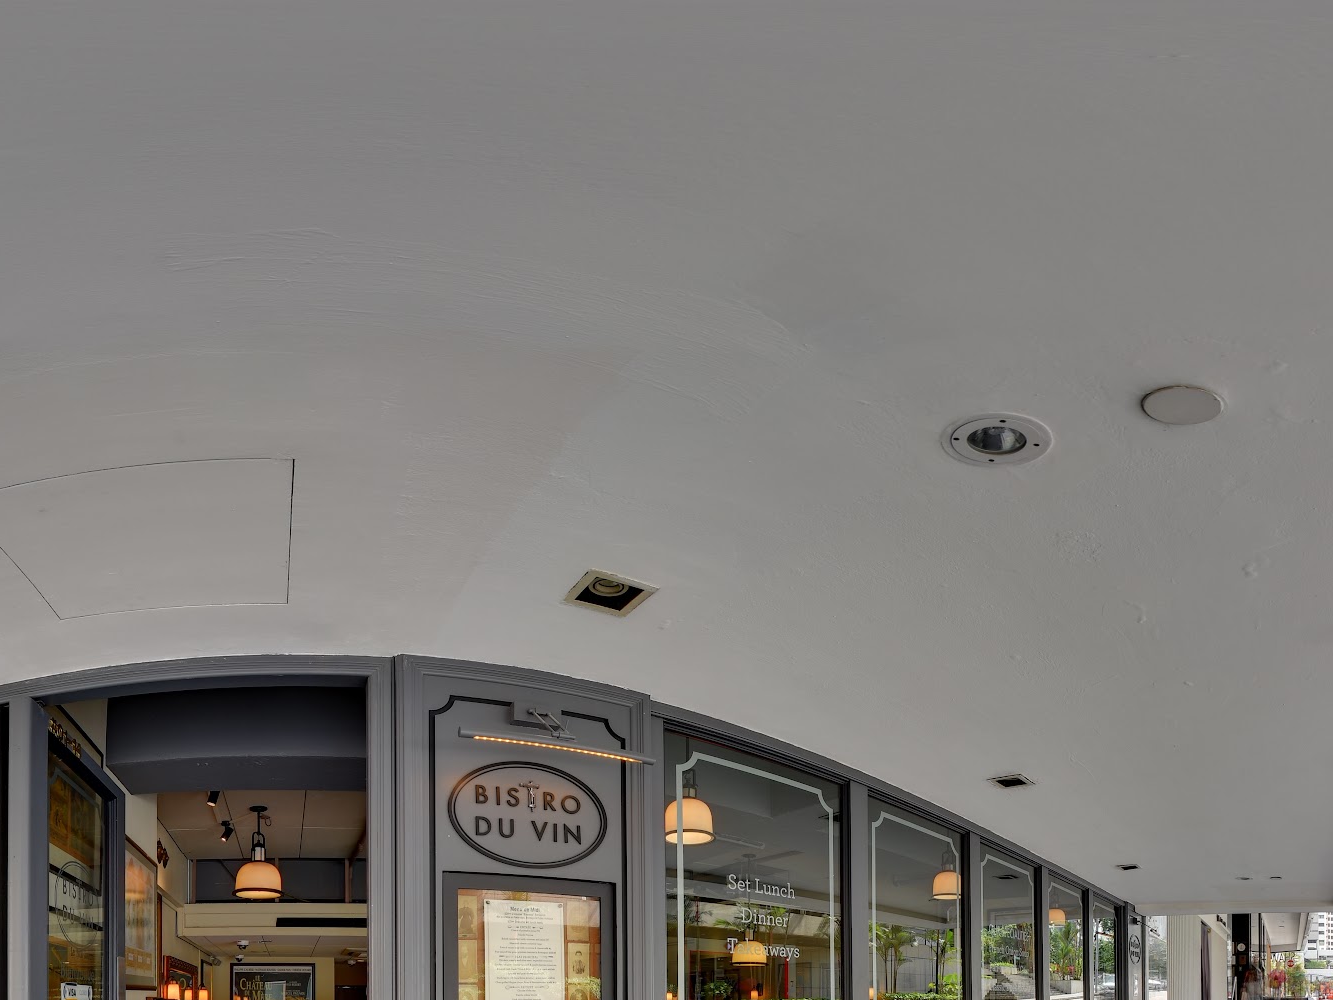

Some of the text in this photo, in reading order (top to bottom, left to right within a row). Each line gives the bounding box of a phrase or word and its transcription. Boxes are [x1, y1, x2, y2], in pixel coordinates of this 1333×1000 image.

[475, 780, 581, 814] BISTRO
[475, 816, 582, 845] DU VIN
[728, 874, 796, 899] Set Lunch
[741, 907, 789, 928] Dinner
[727, 938, 800, 961] Takeaways
